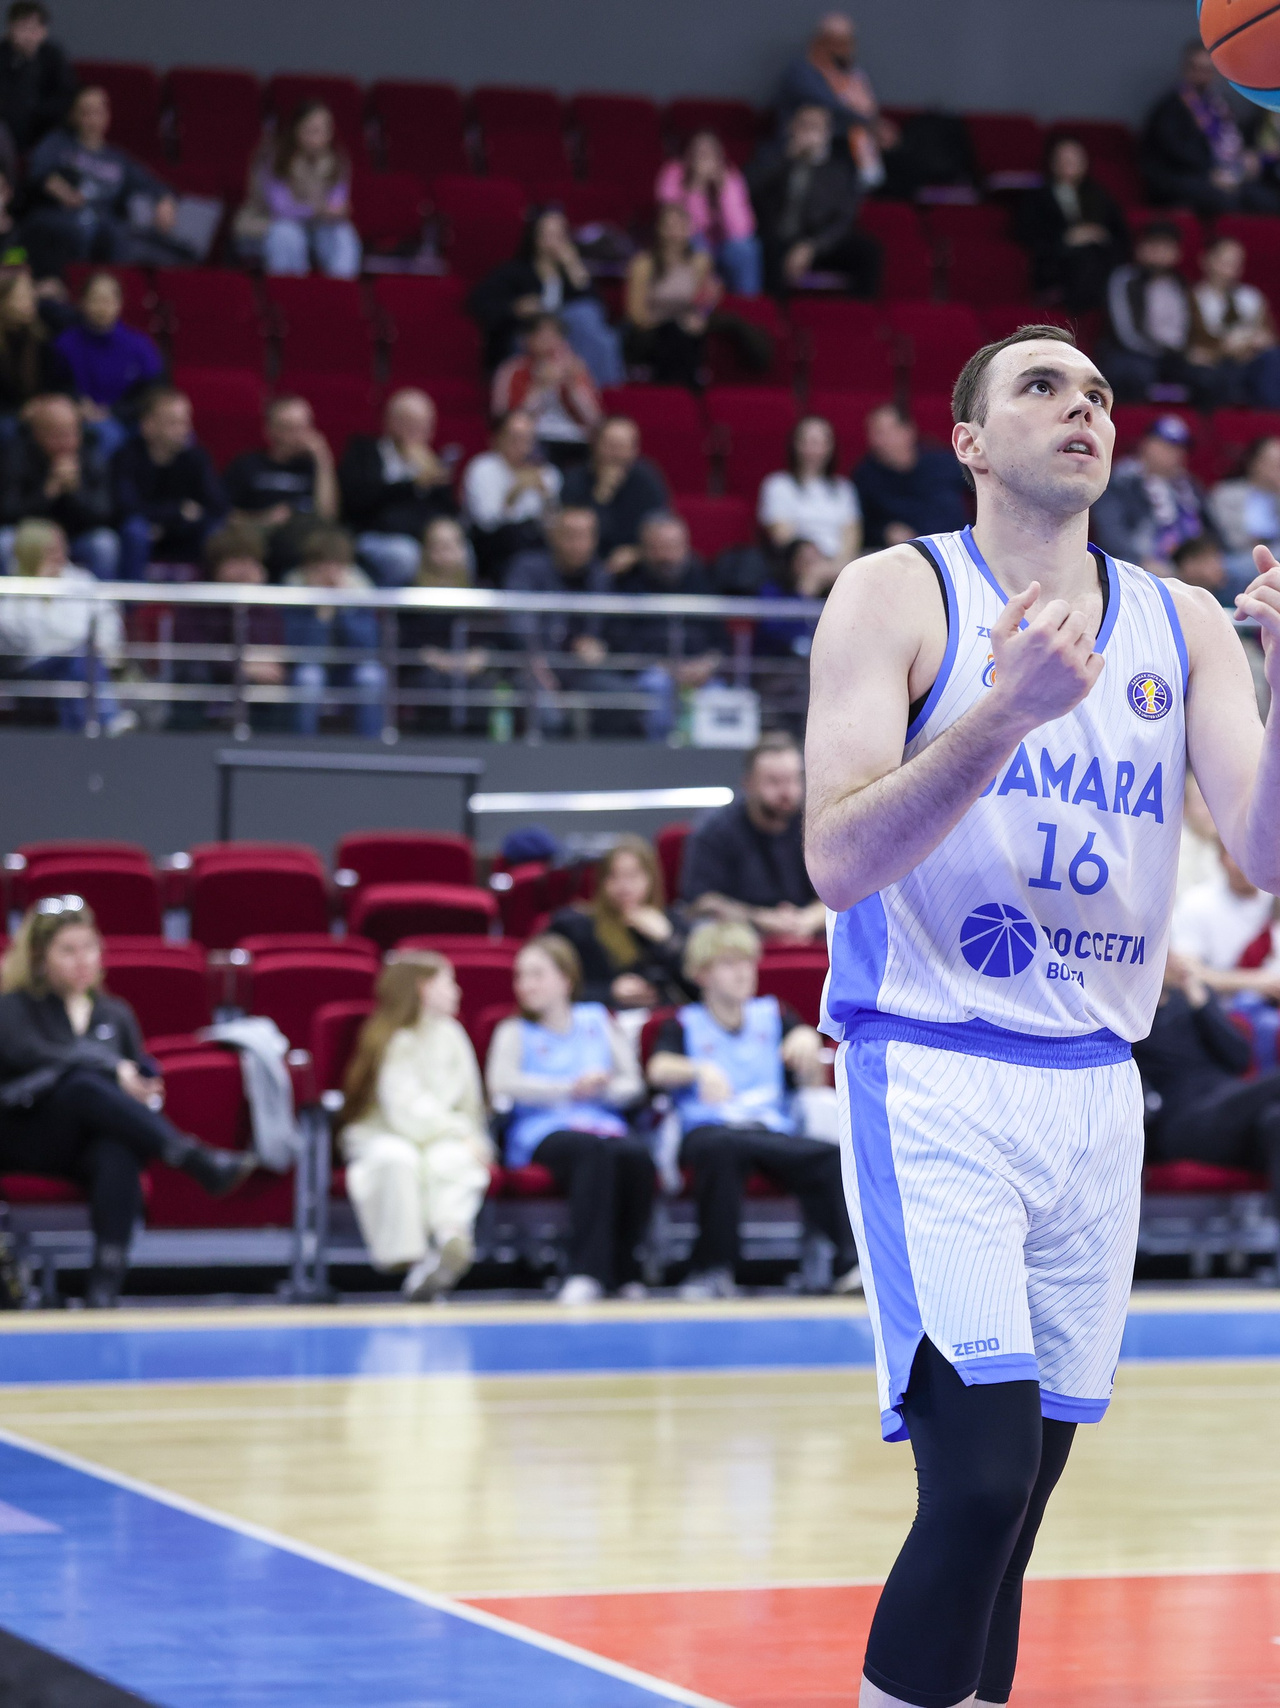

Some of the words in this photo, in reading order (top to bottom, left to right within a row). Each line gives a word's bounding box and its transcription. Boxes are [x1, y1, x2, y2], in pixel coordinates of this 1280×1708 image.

[979, 741, 1164, 825] AMARA
[1028, 822, 1109, 896] 16
[952, 1337, 1000, 1357] ZEDO
